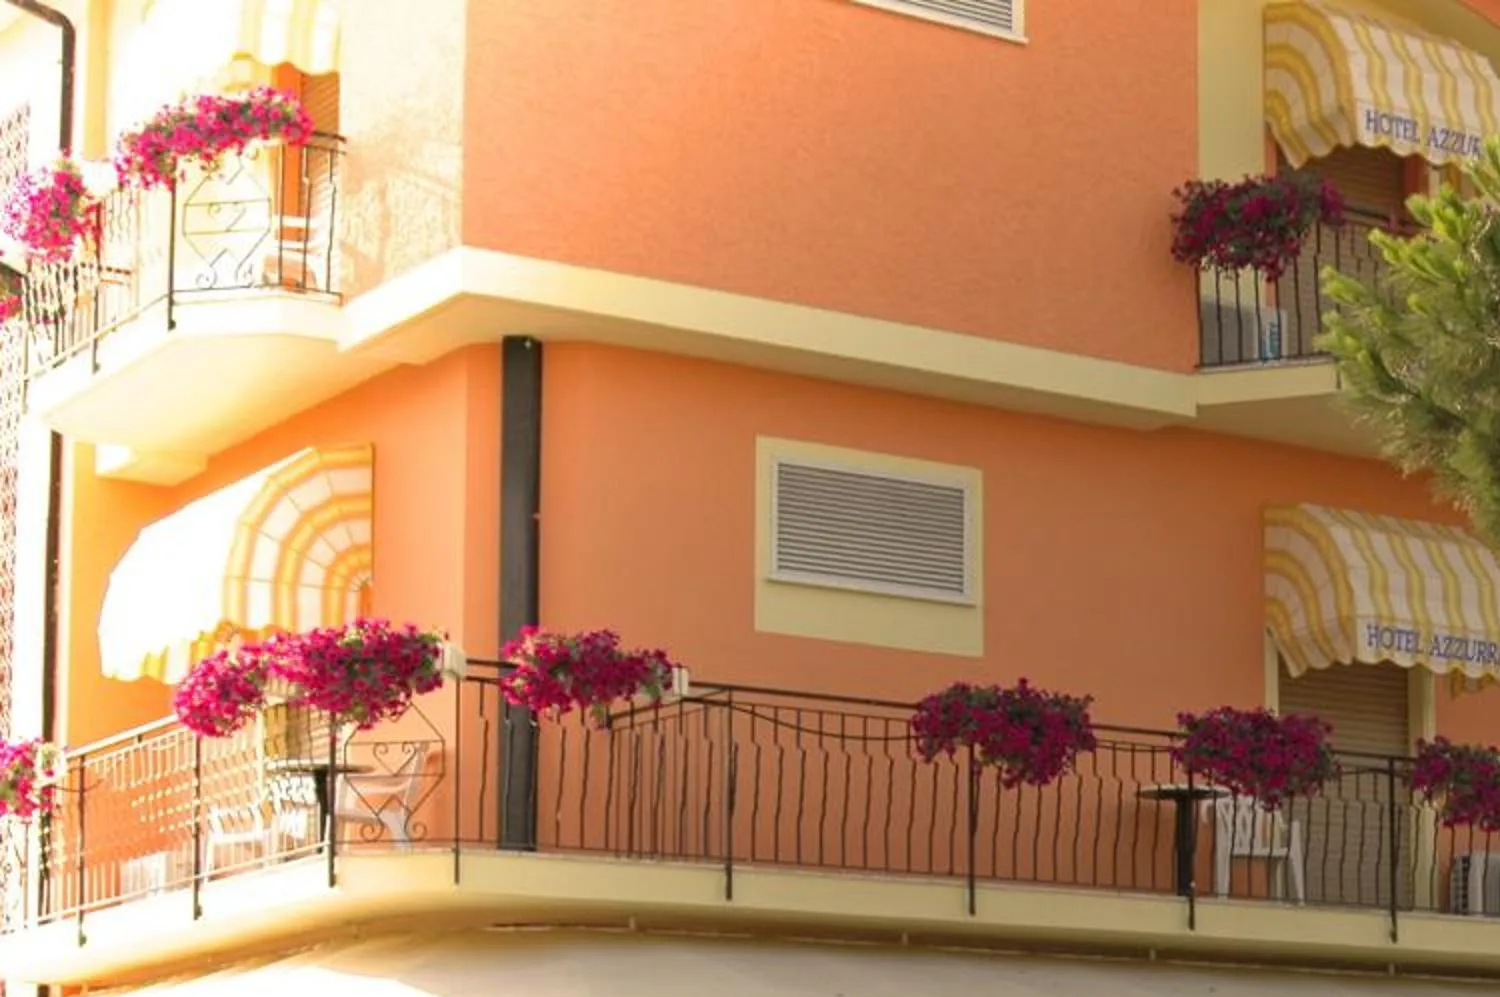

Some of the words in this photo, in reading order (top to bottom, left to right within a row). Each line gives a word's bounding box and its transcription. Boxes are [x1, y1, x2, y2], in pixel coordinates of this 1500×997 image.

[1366, 109, 1420, 143] HOTEL
[1427, 126, 1482, 157] AZZUR
[1366, 623, 1424, 654] HOTEL
